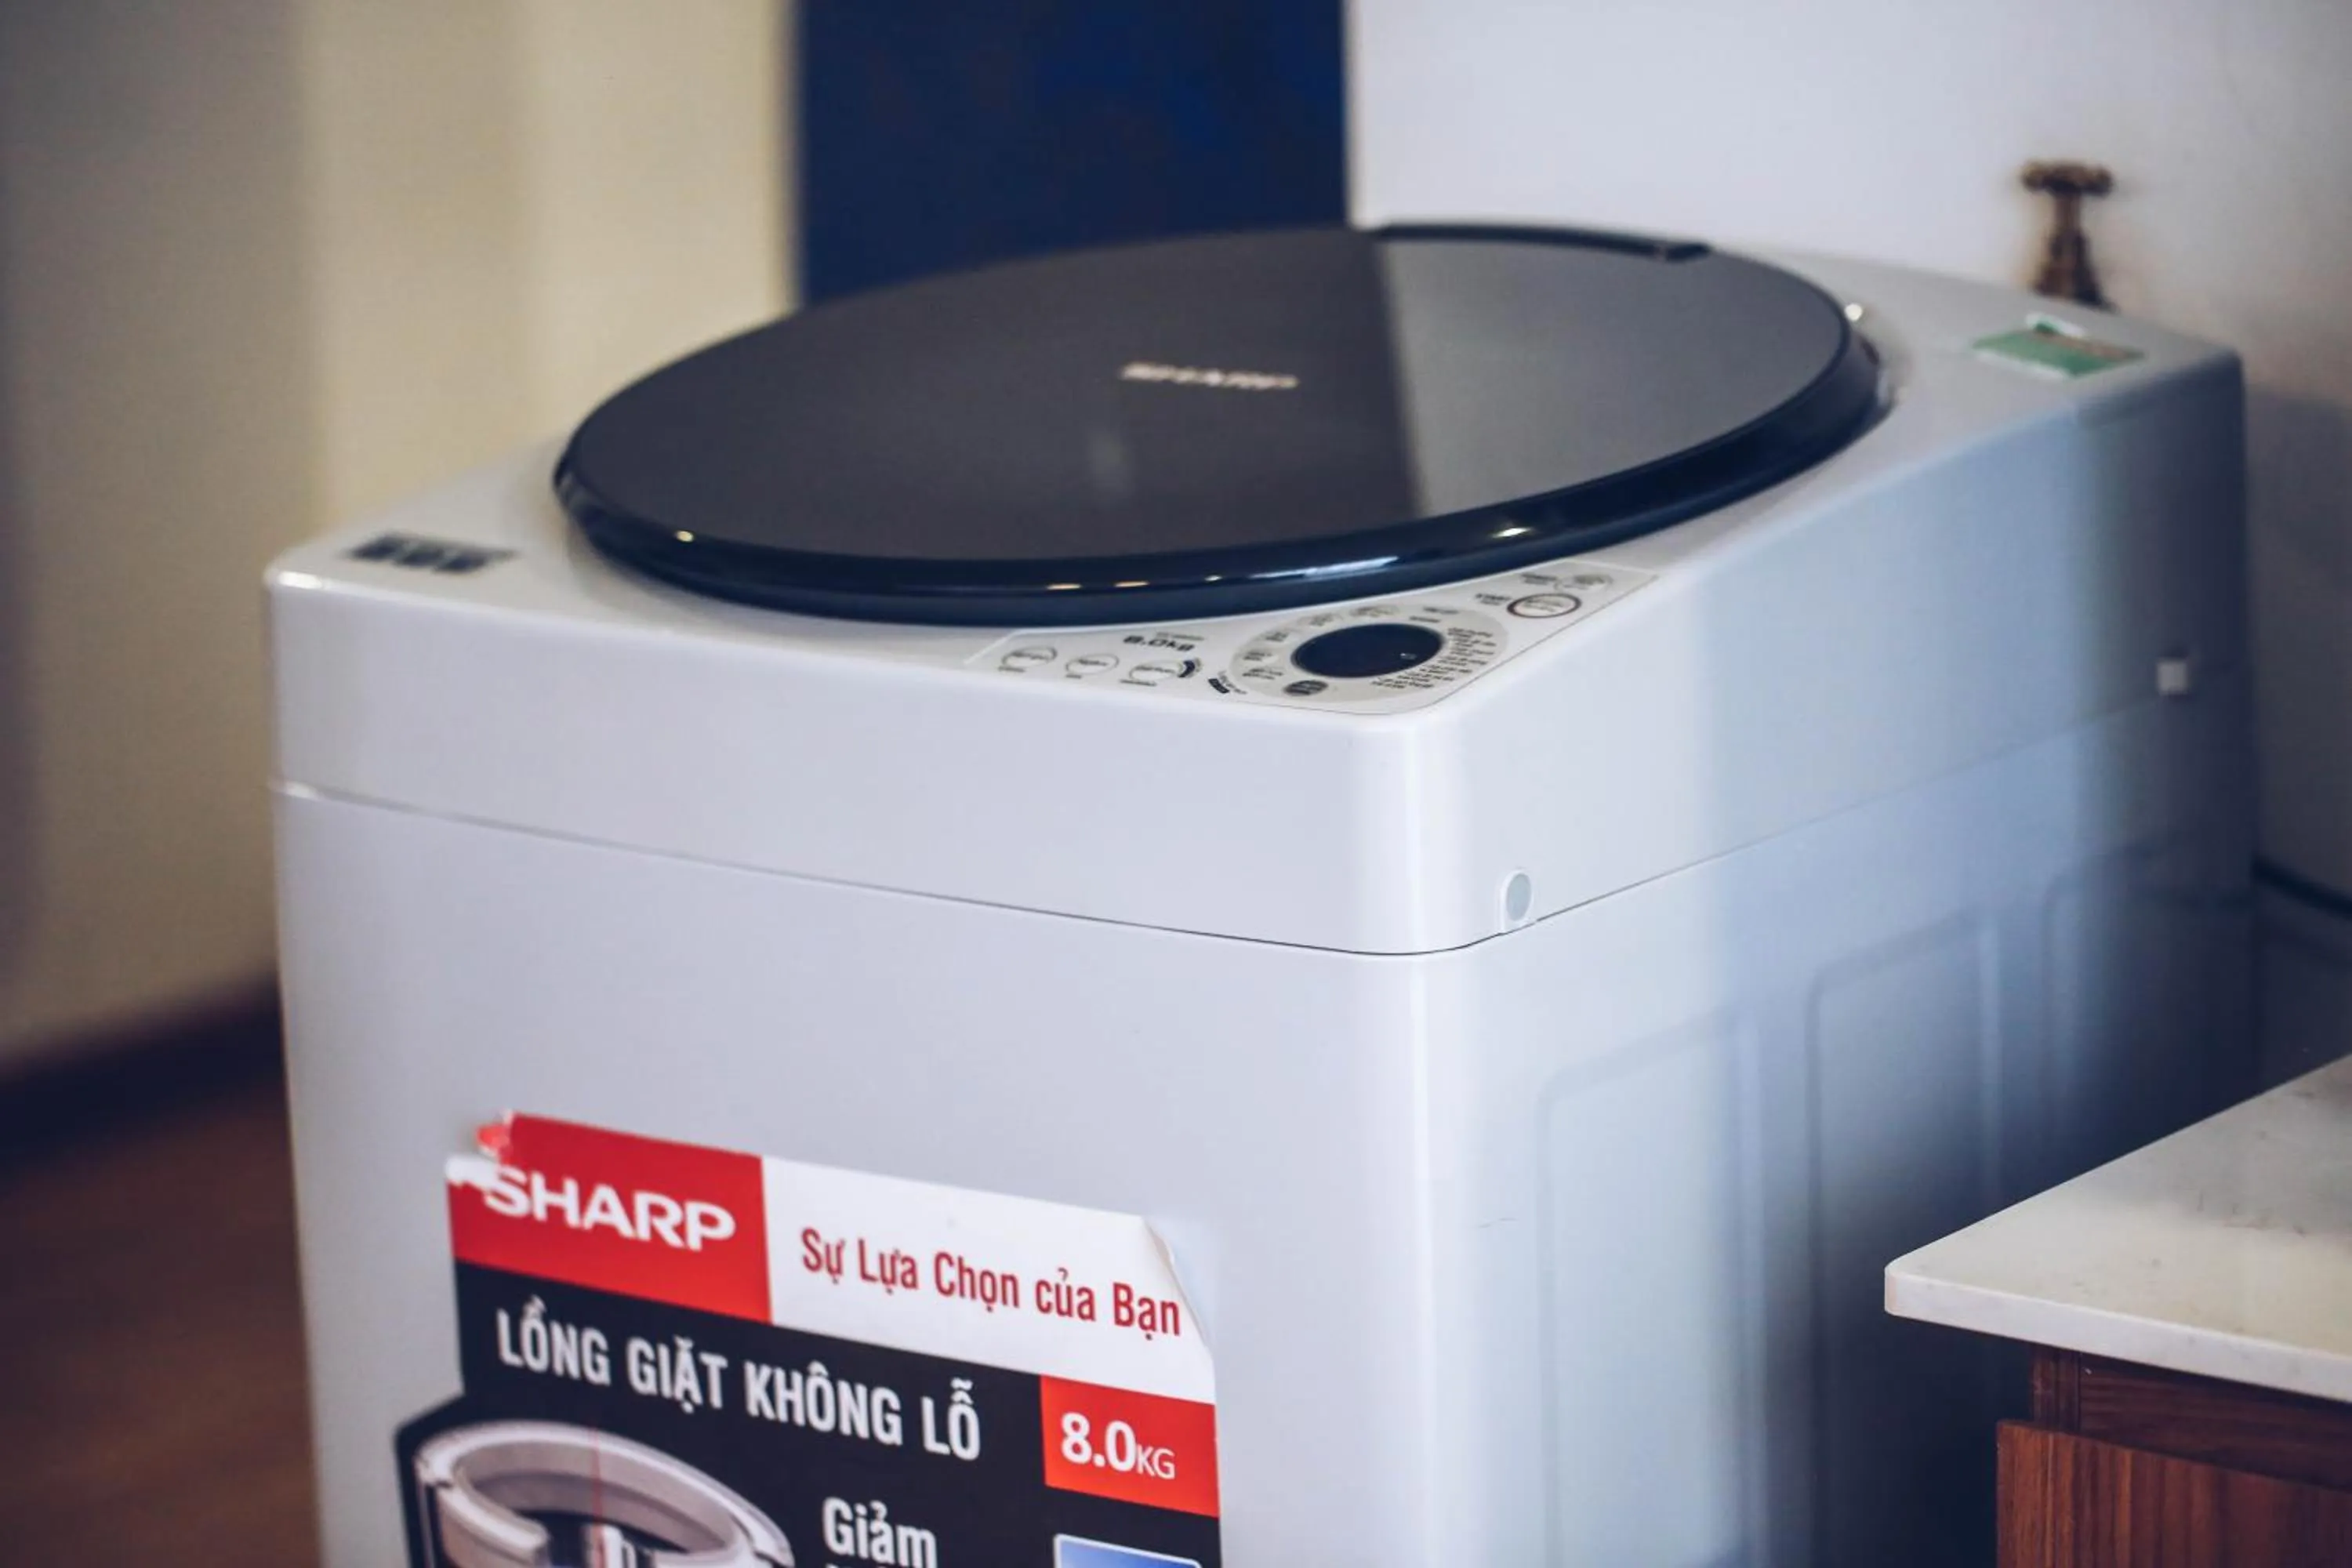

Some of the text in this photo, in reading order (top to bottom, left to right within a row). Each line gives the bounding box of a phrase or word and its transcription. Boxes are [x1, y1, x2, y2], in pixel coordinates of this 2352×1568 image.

[480, 1165, 735, 1251] SHARP
[801, 1227, 1180, 1340] Sự Lựa Chọn của Bạn
[496, 1294, 611, 1386] LỒNG
[744, 1360, 902, 1446] KHÔNG
[920, 1377, 979, 1461] LỖ
[822, 1496, 937, 1568] Giảm
